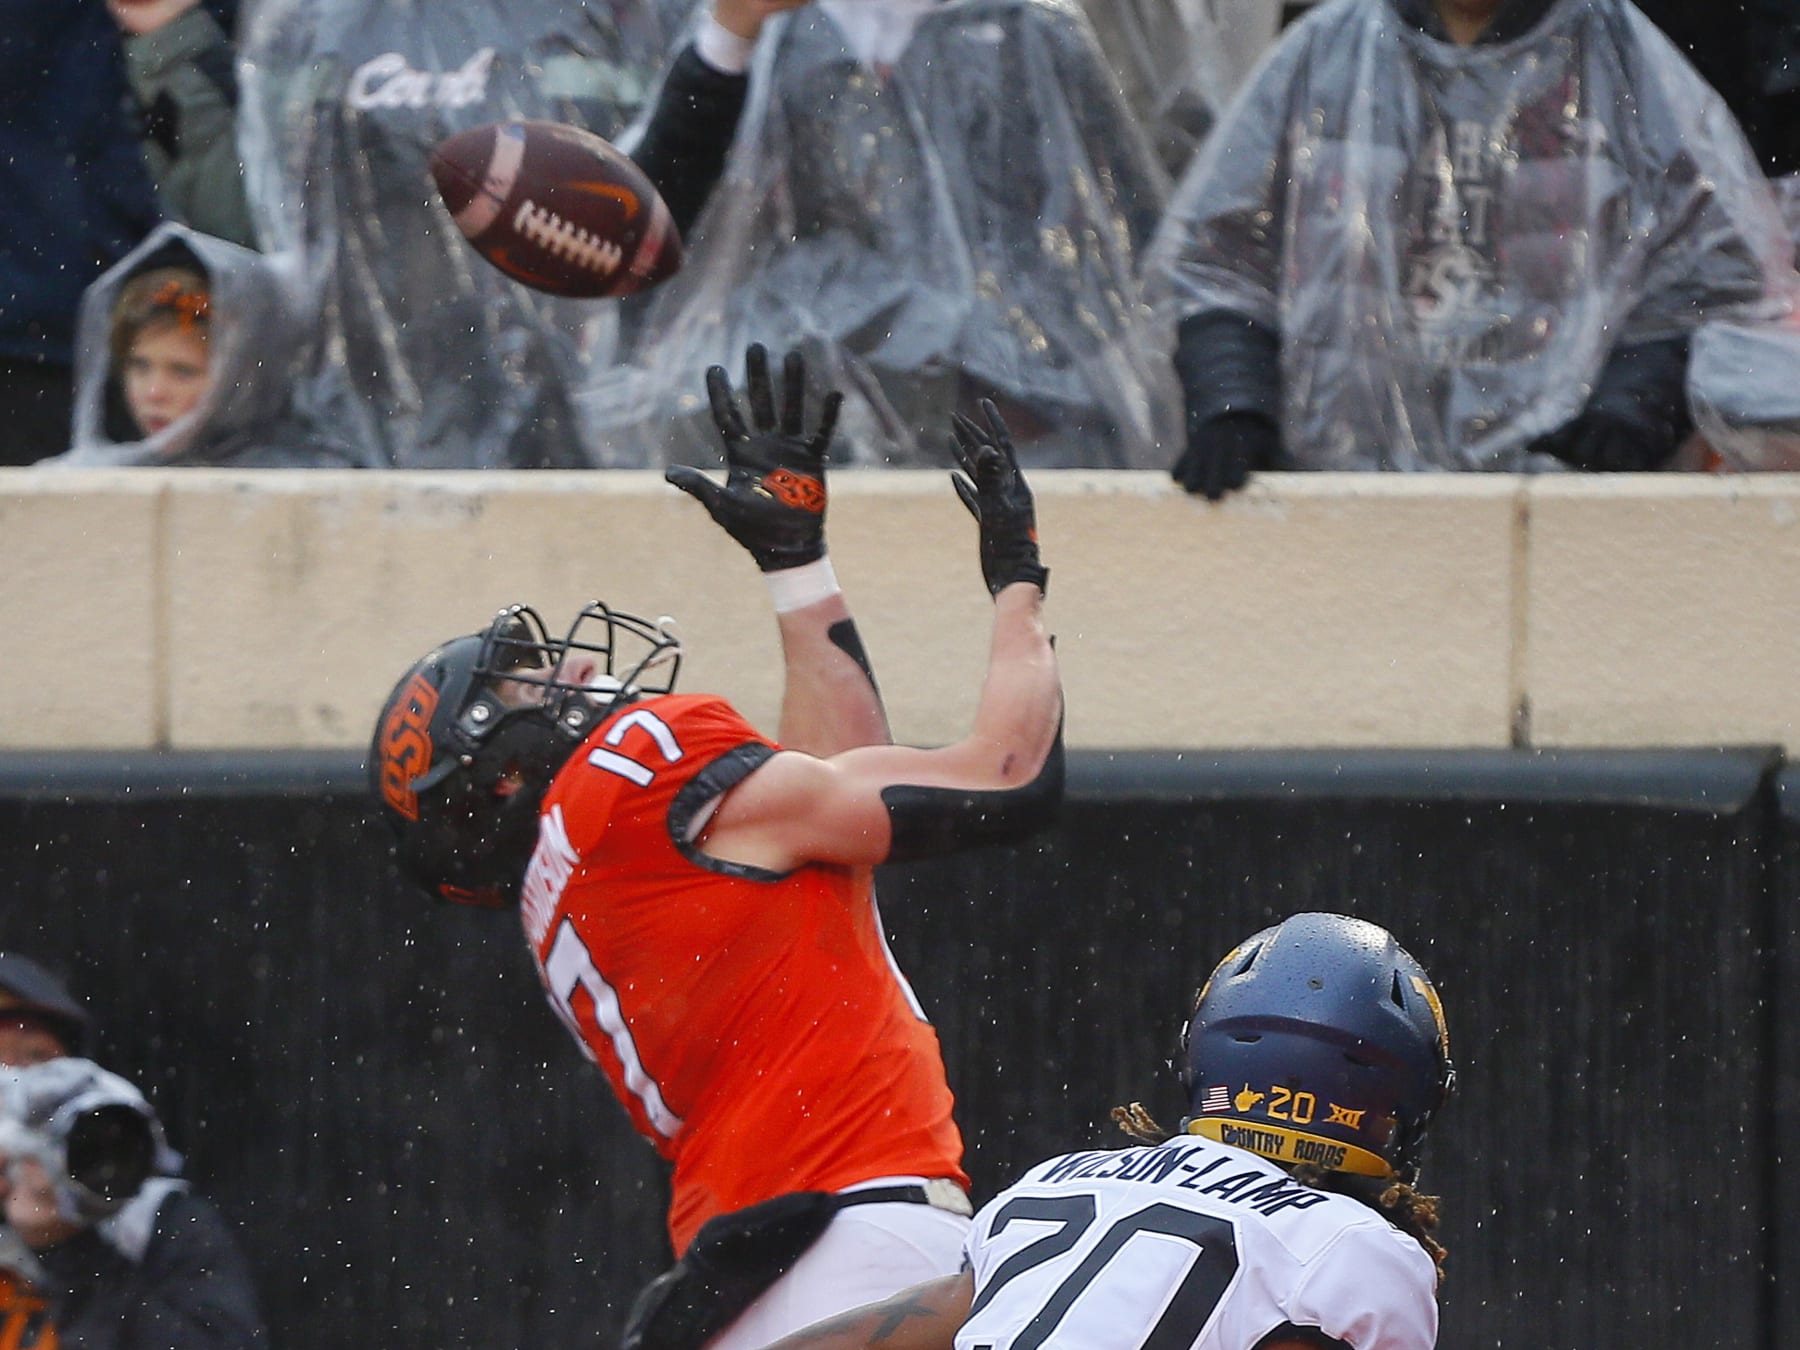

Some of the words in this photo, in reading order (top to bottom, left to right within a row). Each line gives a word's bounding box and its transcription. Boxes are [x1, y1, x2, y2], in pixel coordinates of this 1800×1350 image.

[587, 708, 685, 788] 17
[1266, 1084, 1317, 1125] 20
[1293, 1138, 1347, 1167] ROADS
